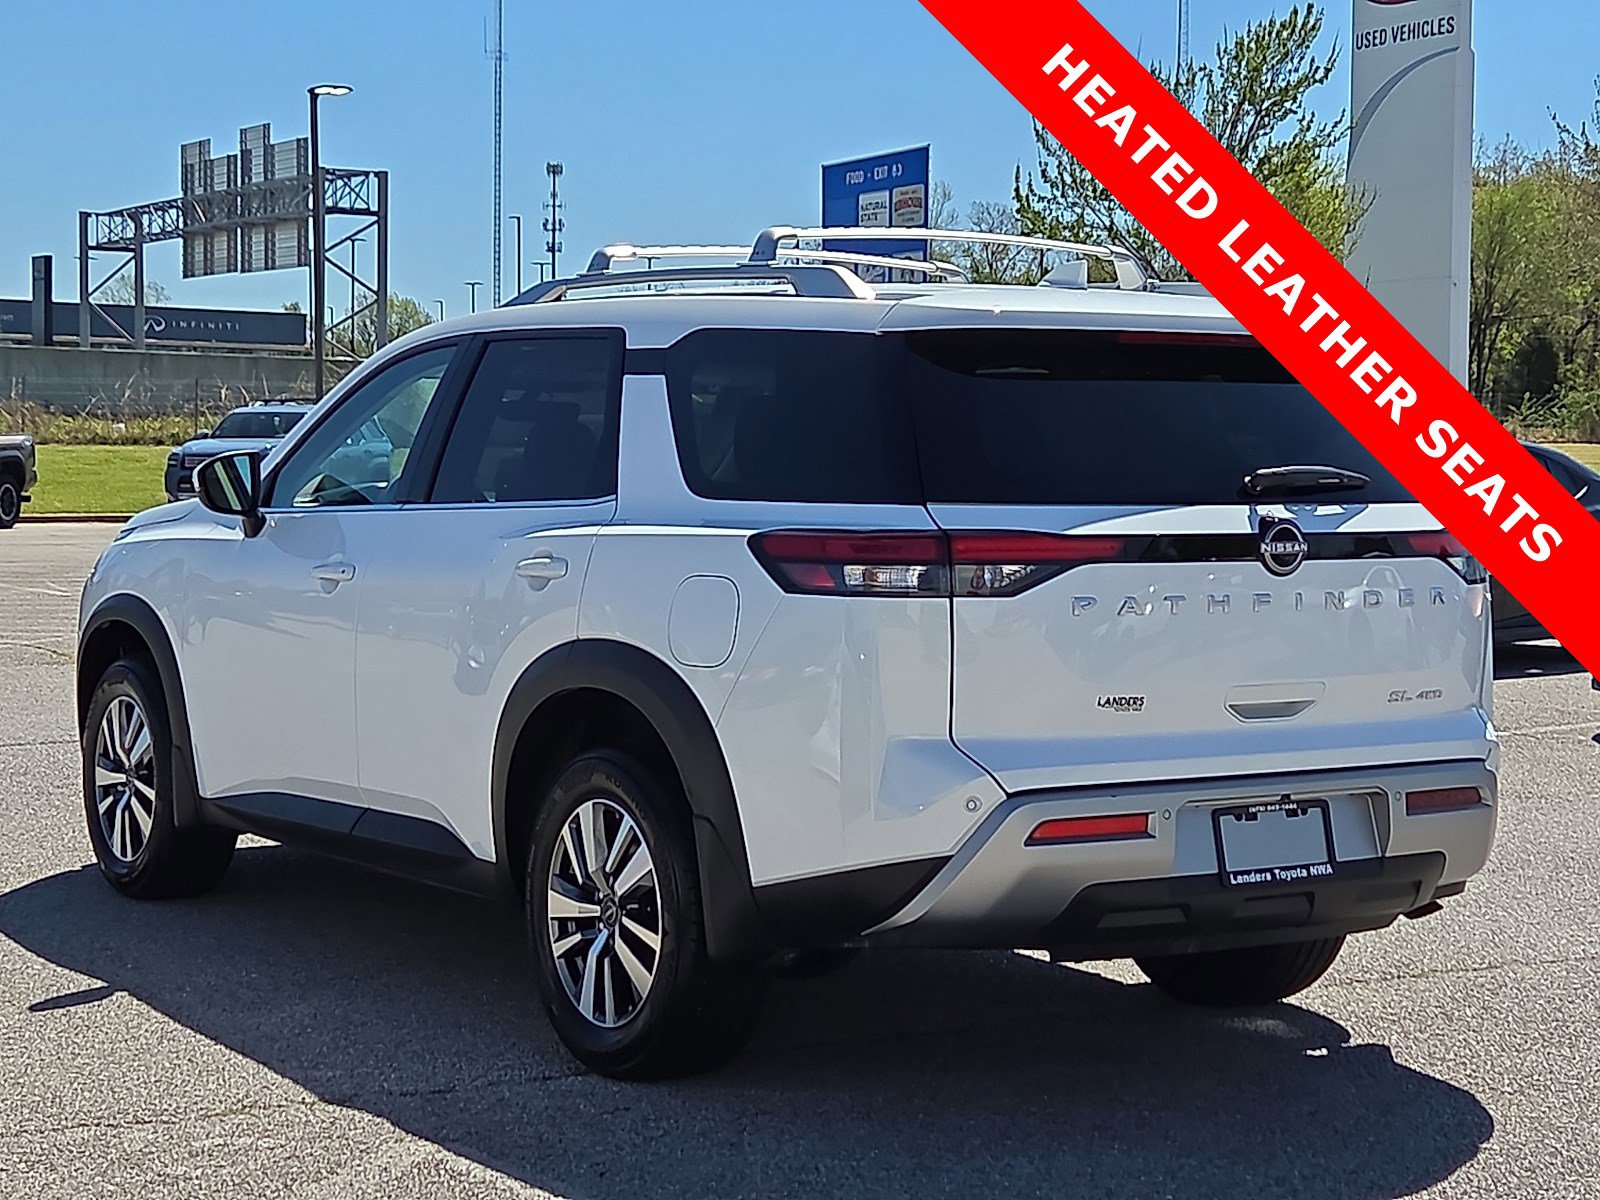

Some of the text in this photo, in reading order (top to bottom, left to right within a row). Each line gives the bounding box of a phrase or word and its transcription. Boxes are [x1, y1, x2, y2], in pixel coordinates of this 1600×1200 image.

[1356, 16, 1456, 51] USED VEHICLES
[846, 171, 865, 185] FOOD
[874, 166, 888, 180] EXIT
[861, 200, 887, 211] NATURAL
[861, 213, 878, 223] STATE
[171, 319, 240, 331] INFINITI
[1260, 541, 1308, 554] NISSAN
[1071, 586, 1447, 618] PATHFINDER
[1096, 695, 1146, 708] LANDERS
[1386, 689, 1413, 704] SL
[1229, 863, 1334, 885] Landers Toyota NWA
